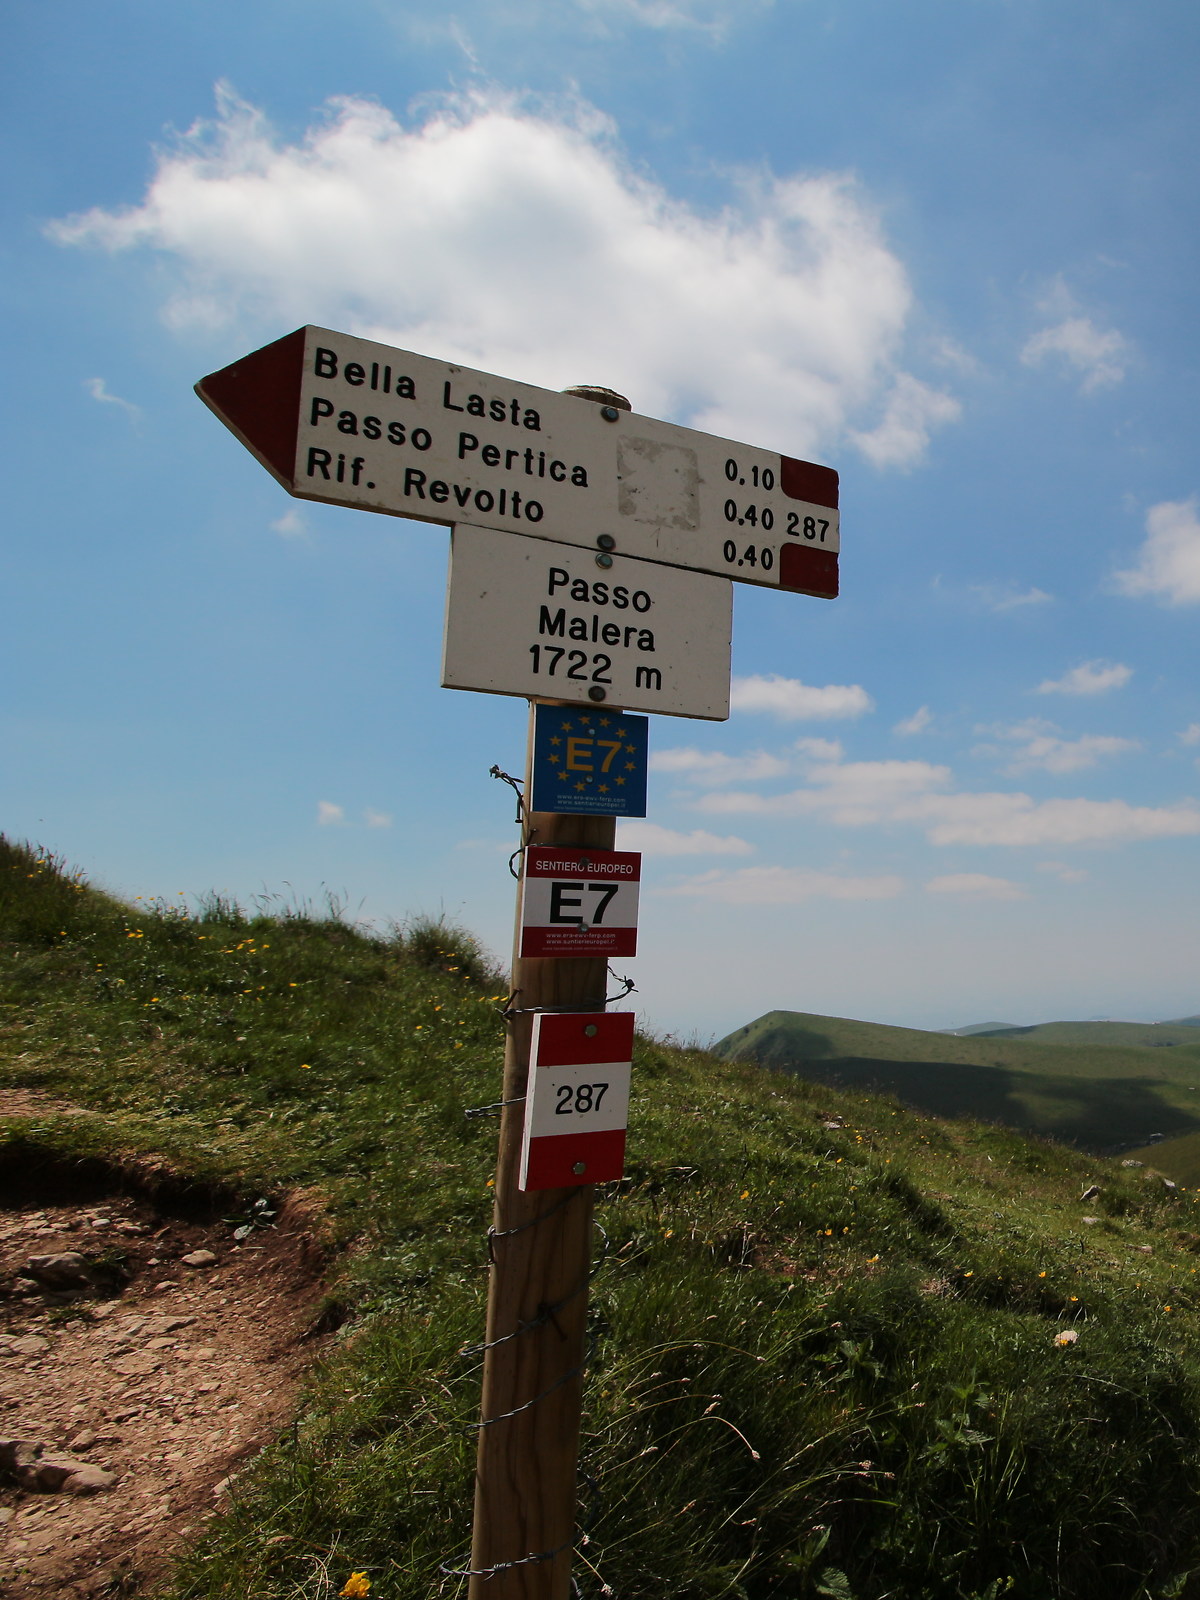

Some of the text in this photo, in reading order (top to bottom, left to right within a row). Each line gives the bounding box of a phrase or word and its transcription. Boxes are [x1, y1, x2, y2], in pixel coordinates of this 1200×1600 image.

[313, 346, 542, 432] Bella Lasta
[309, 396, 589, 488] Passo Pertica
[306, 446, 544, 523] Rif. Revolto
[724, 458, 775, 492] 0.10
[785, 511, 830, 543] 287
[547, 566, 652, 614] Passo
[538, 604, 656, 653] Malera
[529, 643, 662, 691] 1722 m
[566, 736, 622, 773] E7
[535, 860, 634, 874] SENTIERO EUROPEO
[549, 881, 619, 925] E7
[555, 1083, 609, 1115] 287
